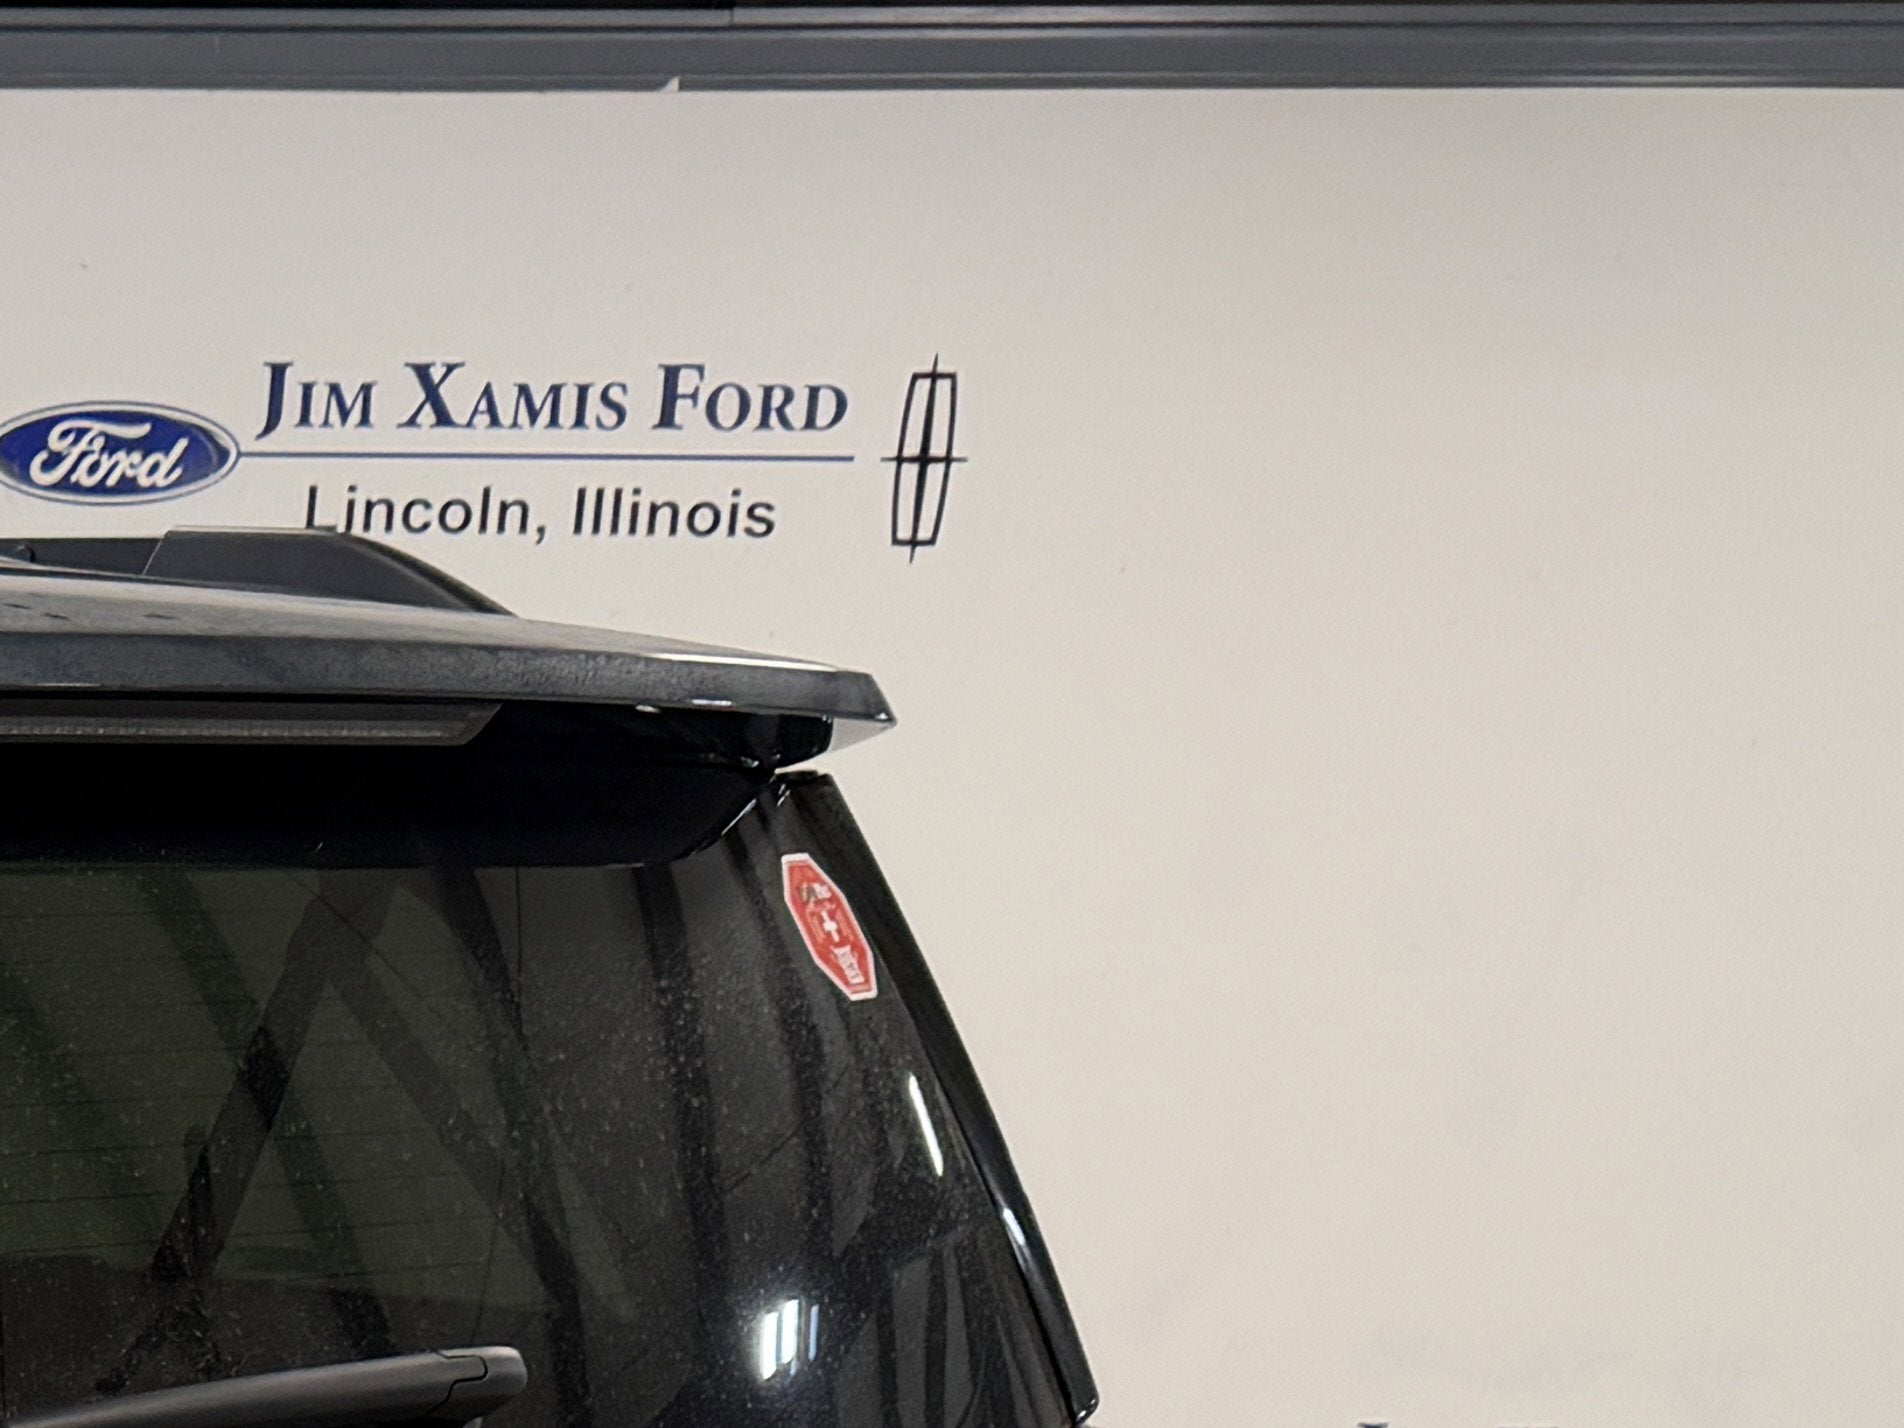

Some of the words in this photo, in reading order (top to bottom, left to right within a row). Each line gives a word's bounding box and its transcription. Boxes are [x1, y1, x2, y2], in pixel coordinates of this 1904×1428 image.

[255, 361, 377, 441] JIM
[396, 361, 628, 431] XAMIS
[651, 363, 849, 432] FORD
[29, 418, 190, 488] Ford
[305, 484, 547, 546] Lincoln,
[572, 487, 776, 539] Illinois
